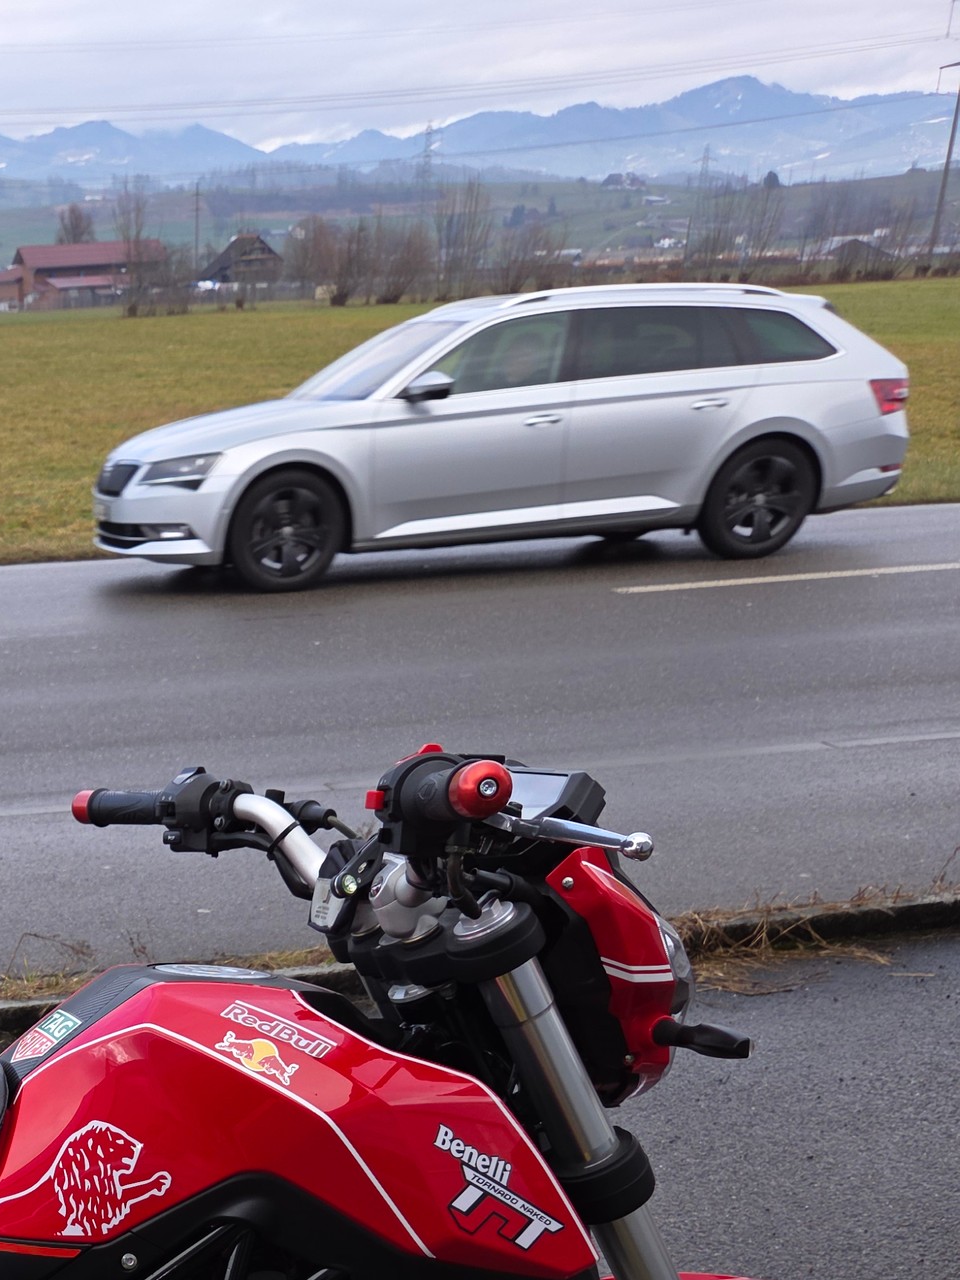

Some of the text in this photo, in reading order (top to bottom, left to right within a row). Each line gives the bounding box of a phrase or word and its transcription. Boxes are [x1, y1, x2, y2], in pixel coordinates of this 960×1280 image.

[41, 1013, 74, 1038] TAG
[220, 1003, 333, 1058] RedBull
[434, 1123, 513, 1187] Benelli
[470, 1172, 553, 1227] TORNADO NAKED
